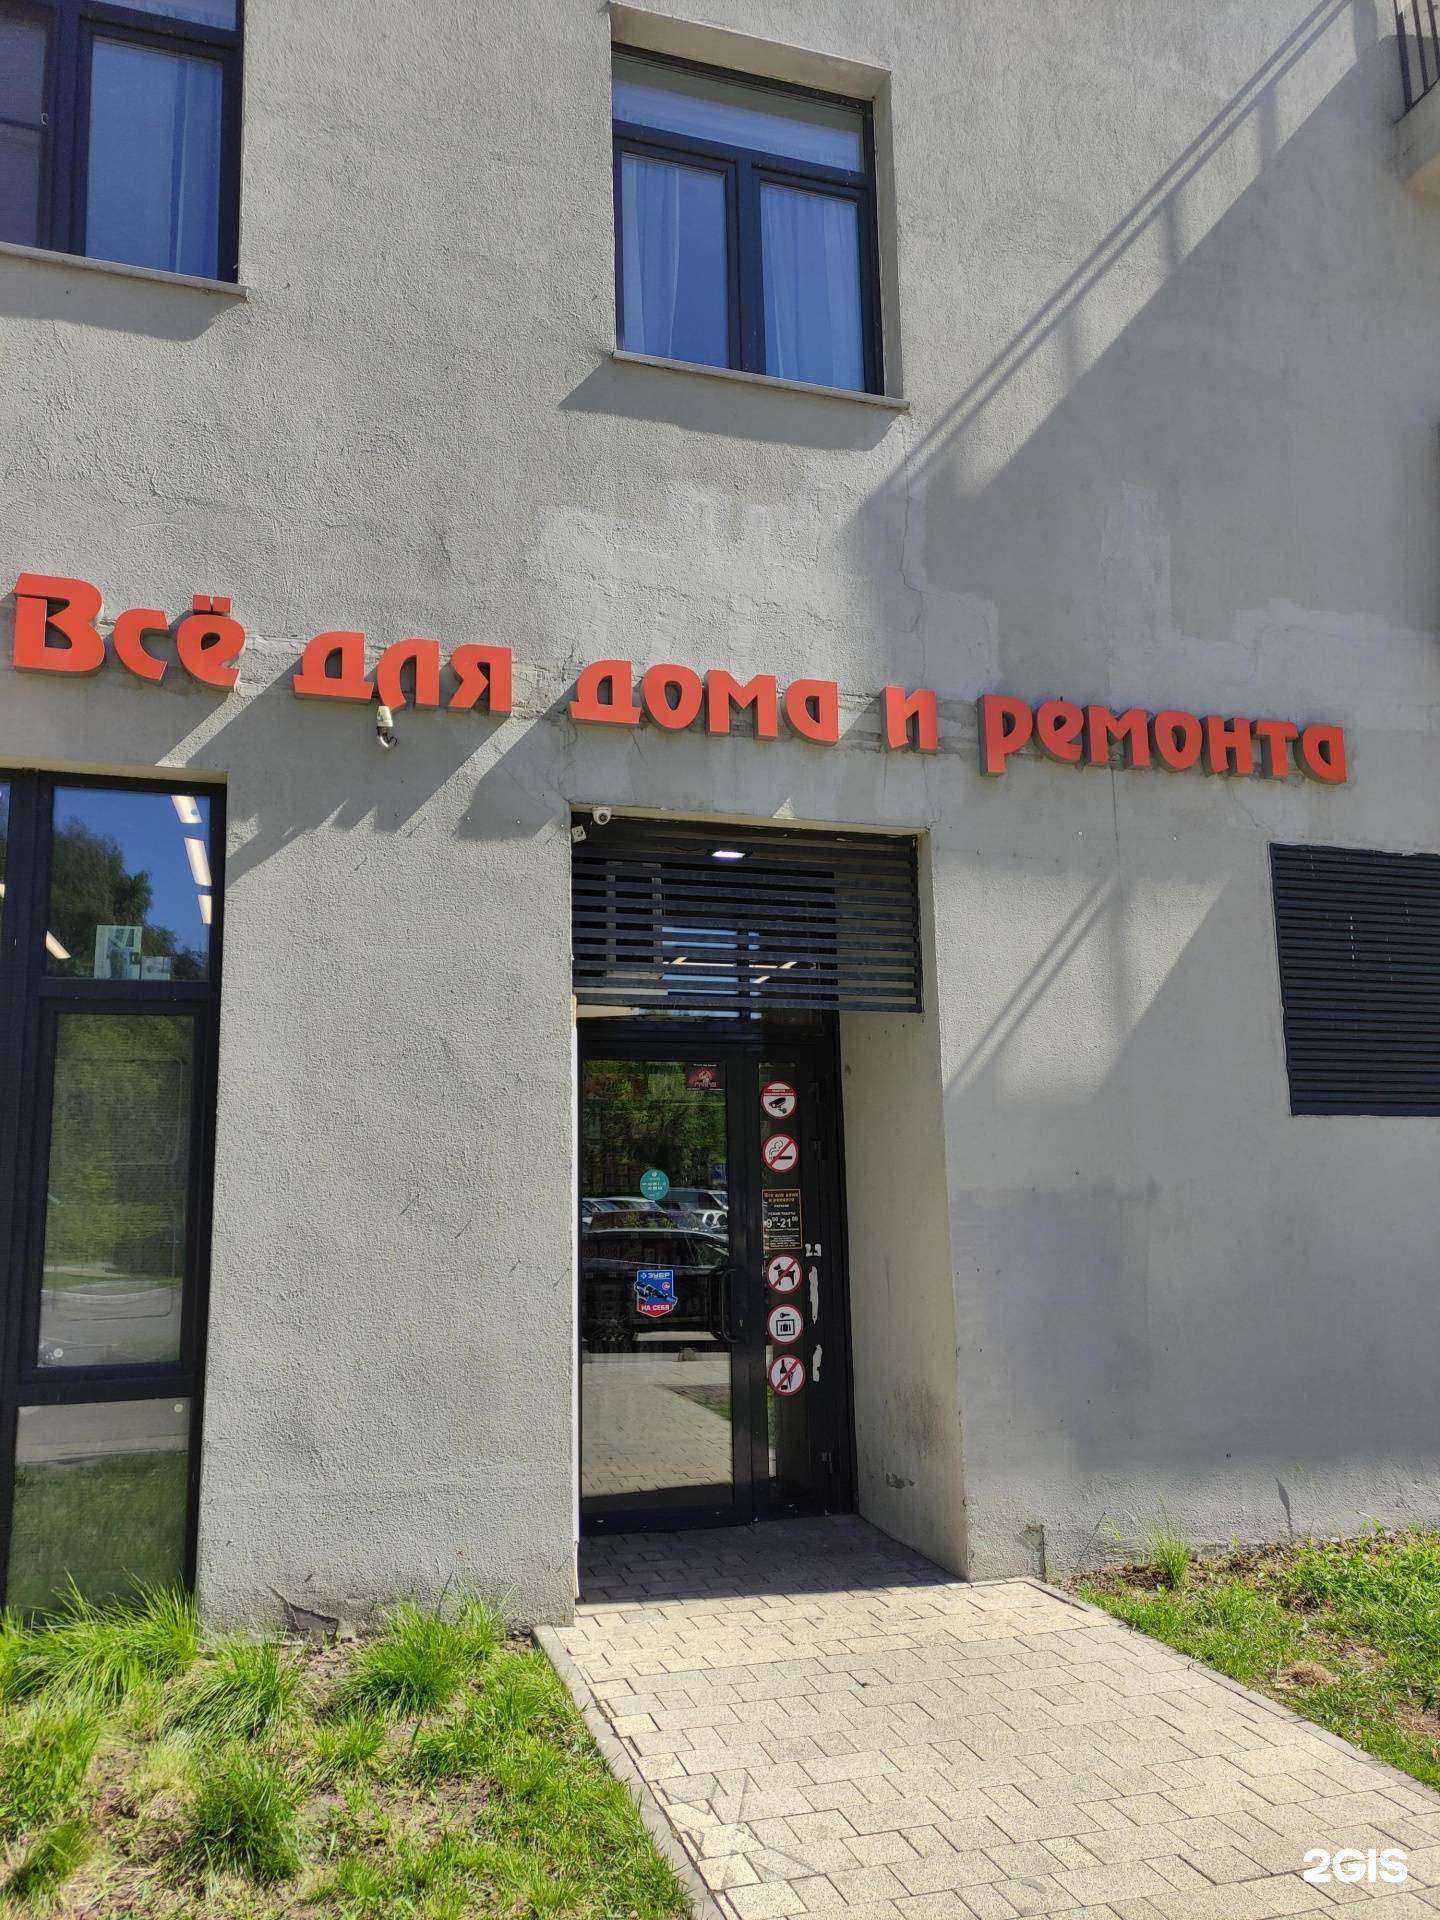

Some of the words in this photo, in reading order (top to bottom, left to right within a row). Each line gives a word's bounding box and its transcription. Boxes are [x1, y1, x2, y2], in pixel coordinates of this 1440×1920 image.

[12, 572, 245, 687] Всё
[292, 631, 513, 712] для
[570, 659, 840, 742] дома
[977, 695, 1347, 783] ремонта
